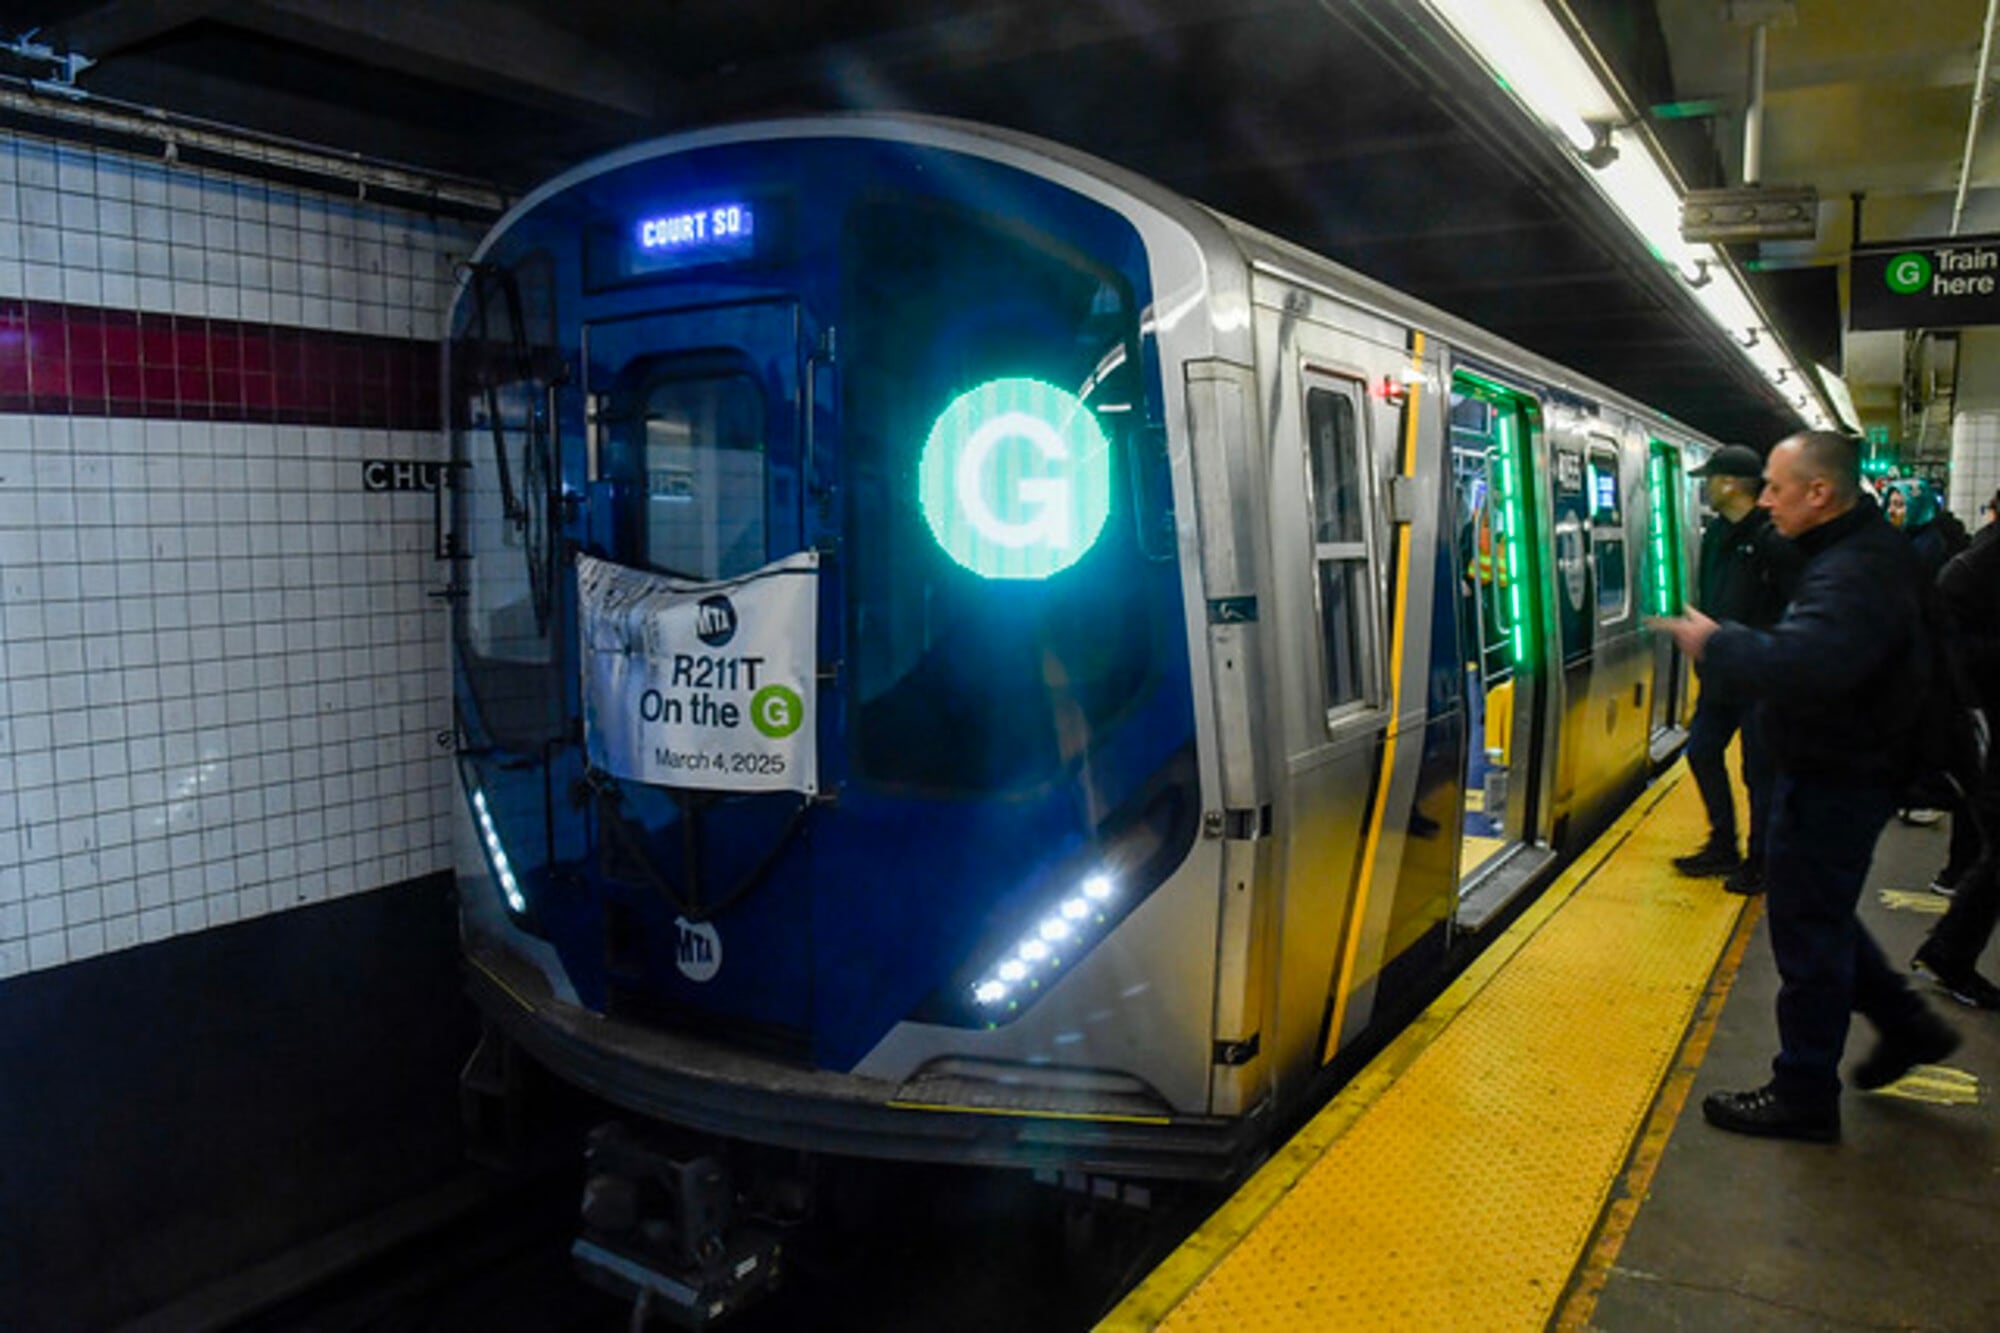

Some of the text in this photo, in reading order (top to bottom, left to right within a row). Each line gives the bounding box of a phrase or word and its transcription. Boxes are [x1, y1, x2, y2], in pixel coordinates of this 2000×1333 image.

[643, 211, 706, 247] COURT
[1896, 248, 1998, 285] G Train
[1933, 274, 1994, 295] here
[957, 411, 1071, 549] G
[699, 604, 731, 635] MTA
[672, 654, 764, 691] R211T
[640, 689, 790, 728] On the G
[655, 748, 786, 775] March 4, 2025
